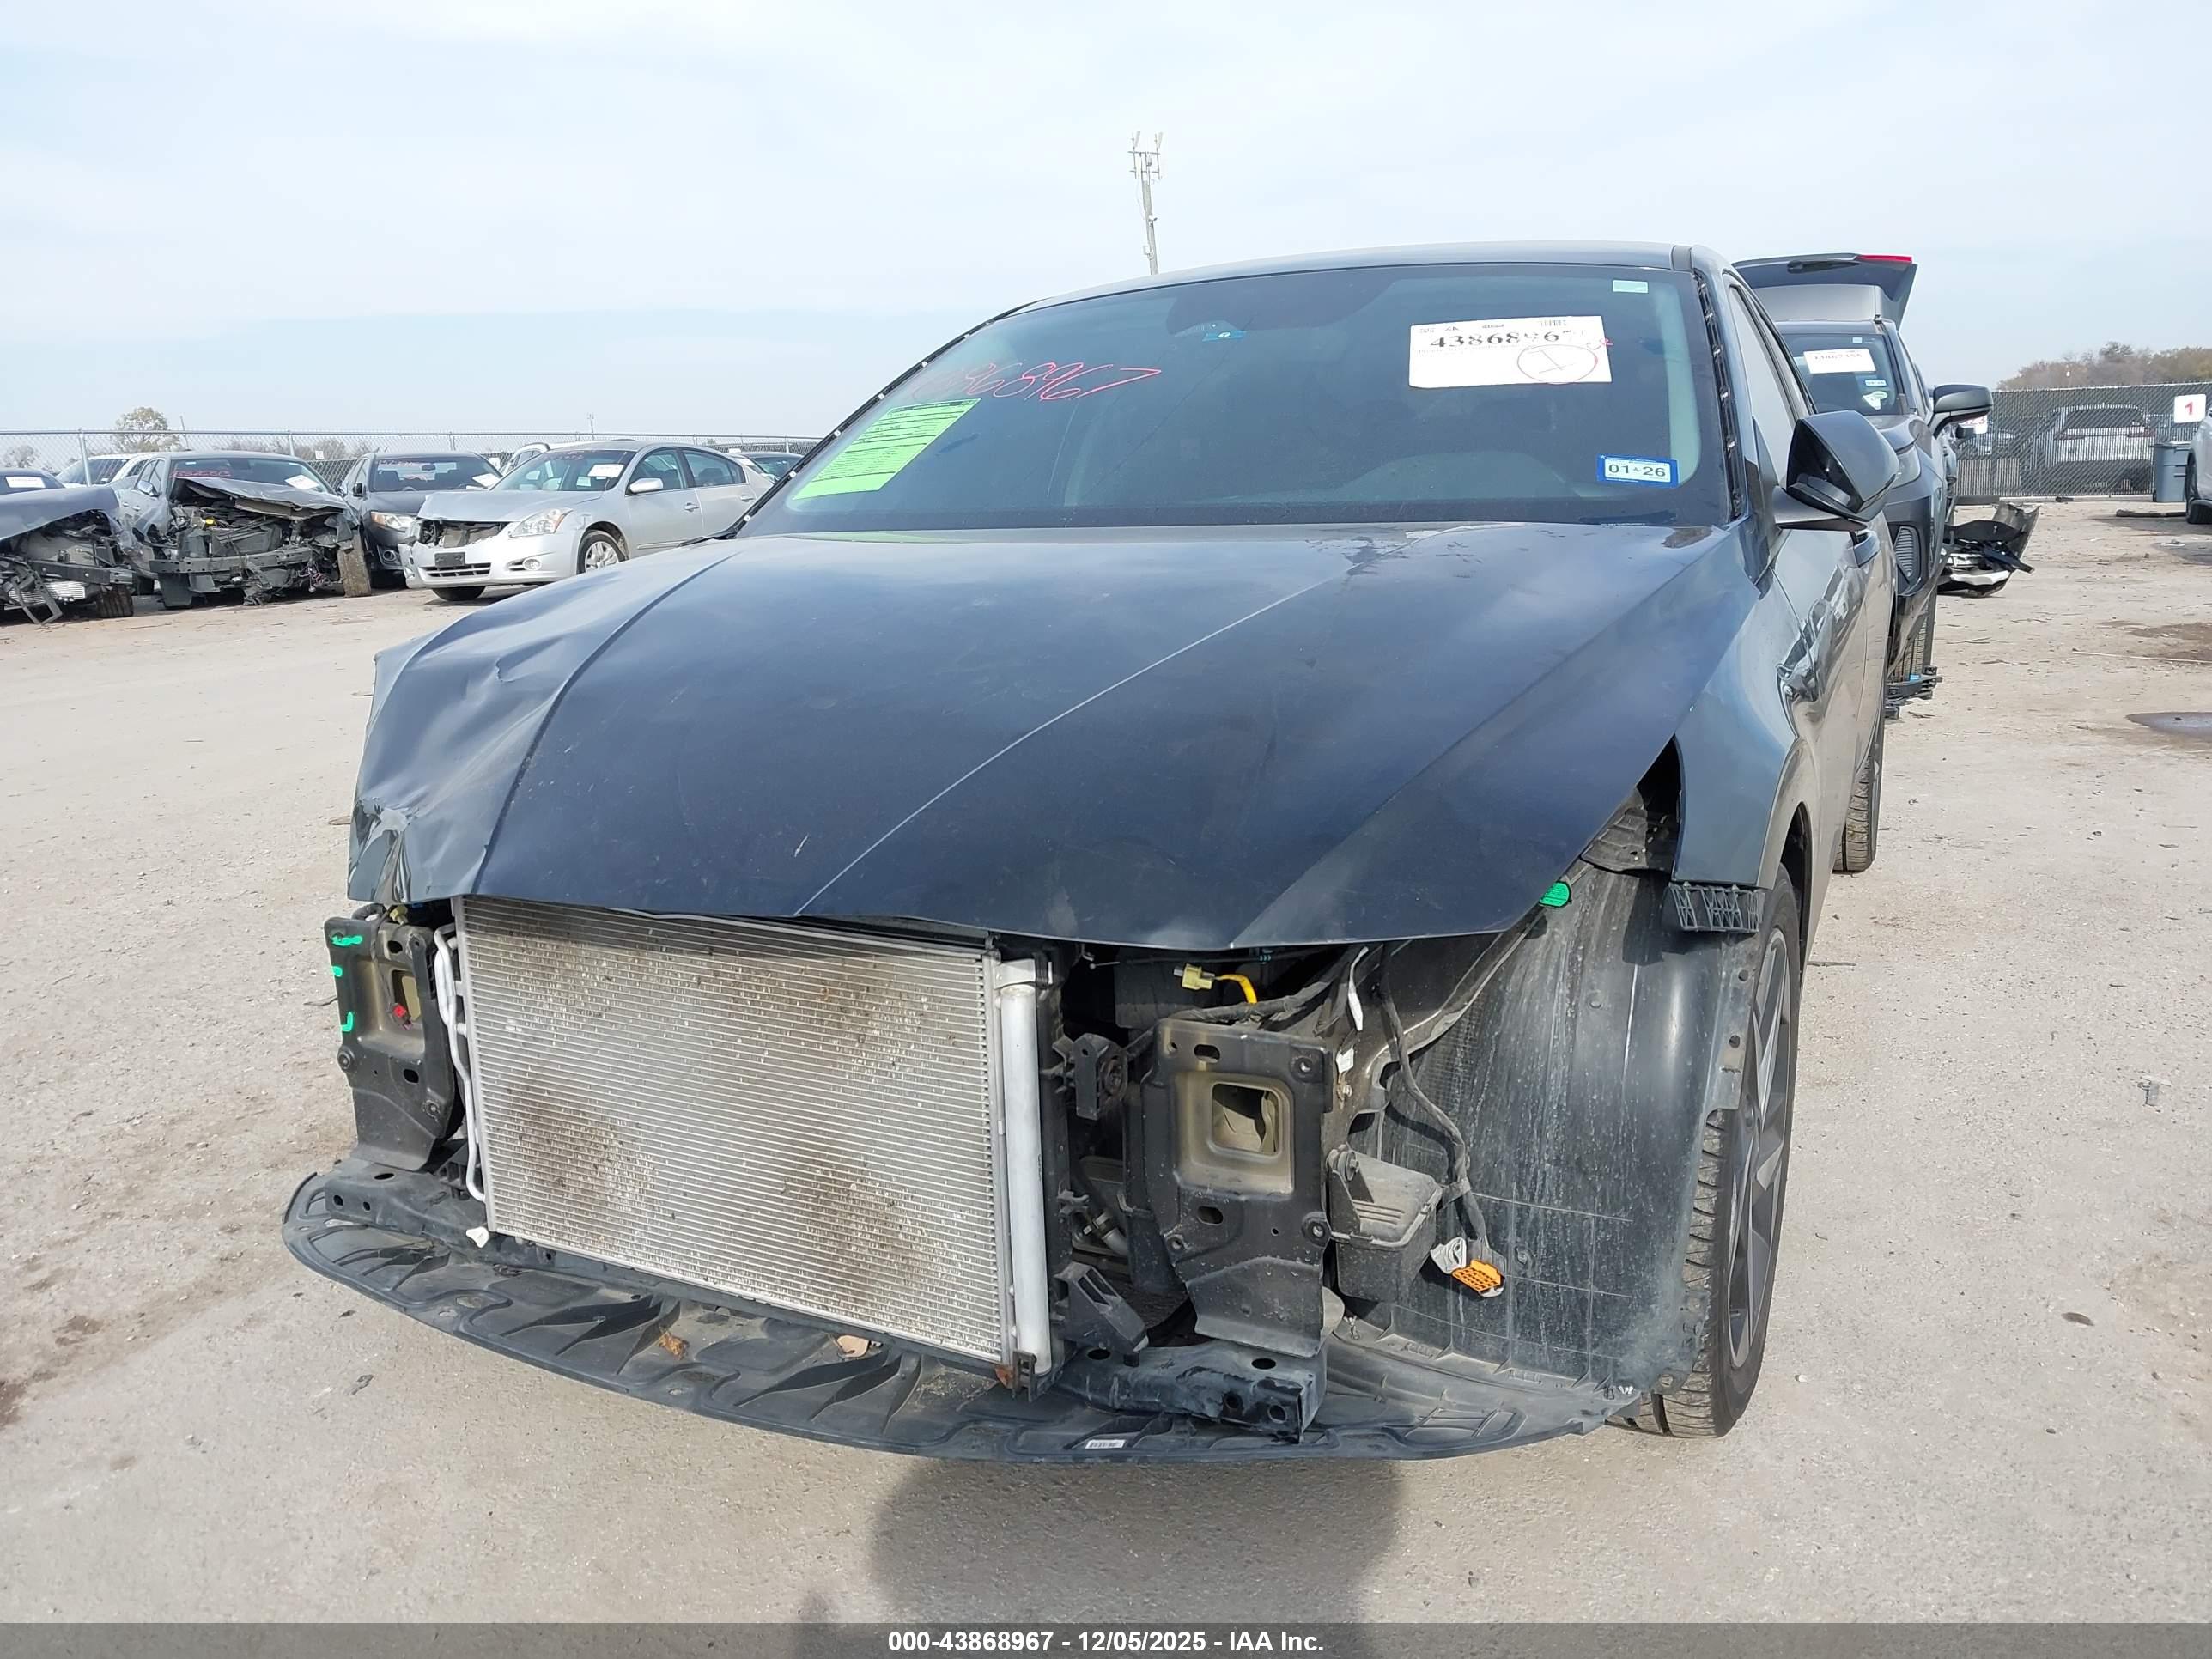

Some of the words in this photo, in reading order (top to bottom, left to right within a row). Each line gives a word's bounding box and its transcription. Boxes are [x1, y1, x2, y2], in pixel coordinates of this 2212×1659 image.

[912, 362, 1162, 402] 868967
[2184, 401, 2194, 416] 1
[1608, 464, 1630, 474] 01
[1642, 466, 1667, 477] 26
